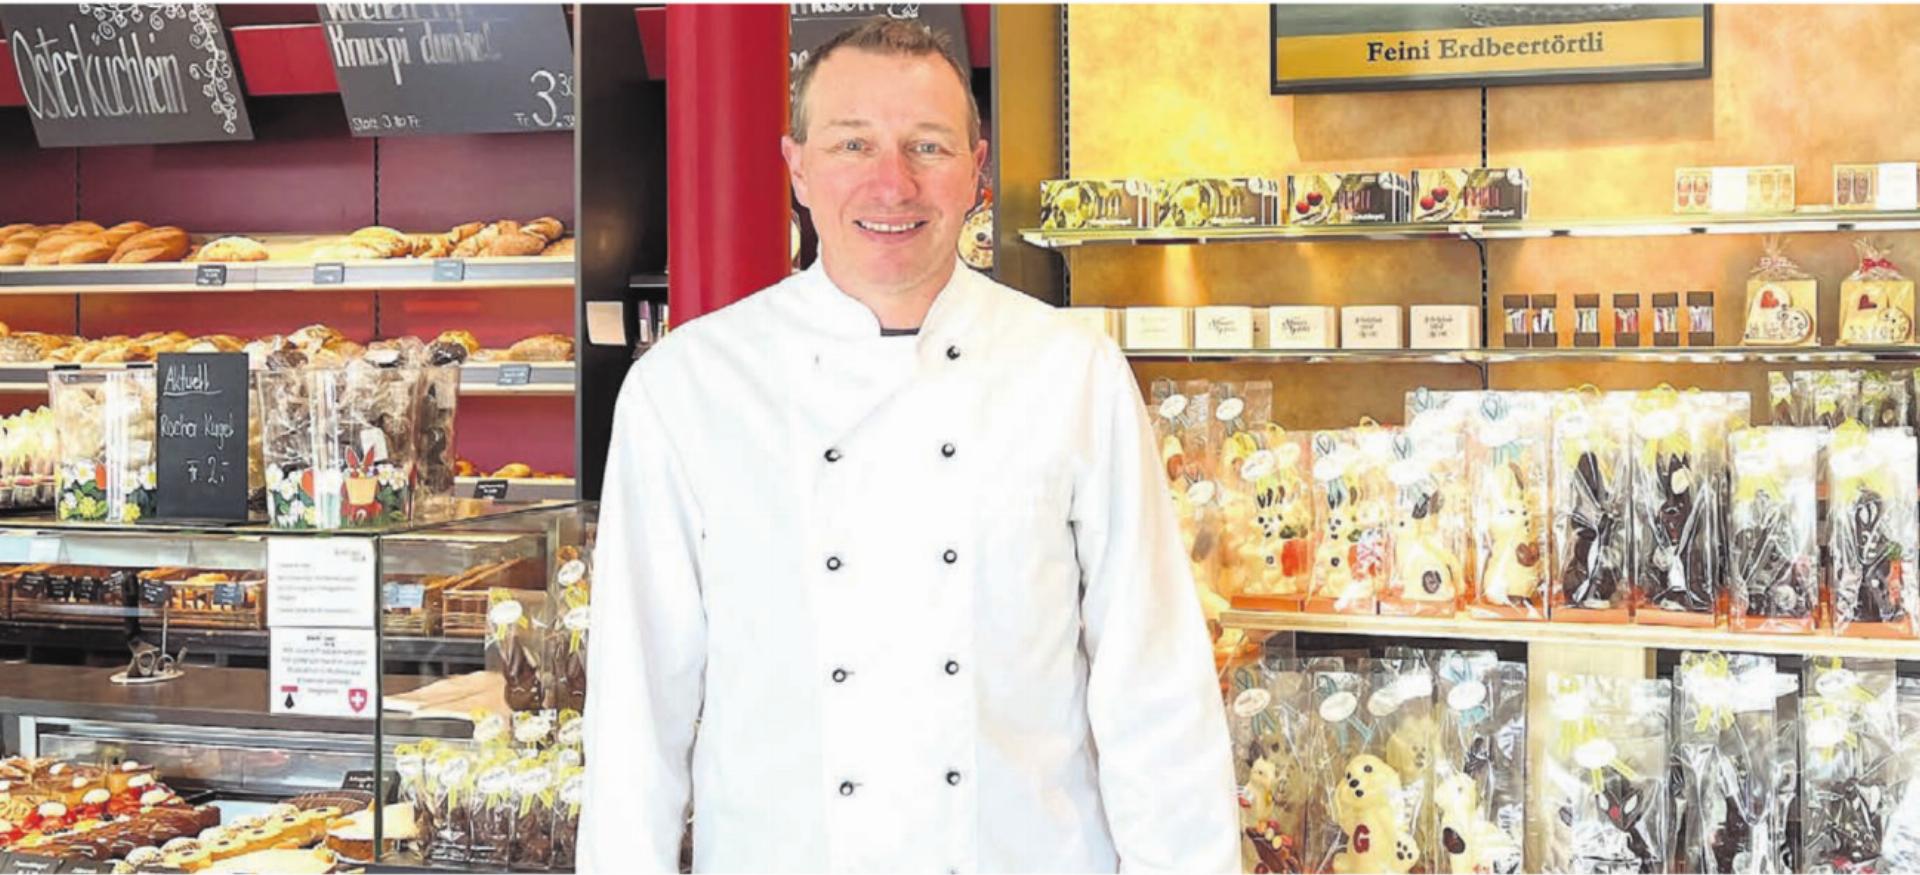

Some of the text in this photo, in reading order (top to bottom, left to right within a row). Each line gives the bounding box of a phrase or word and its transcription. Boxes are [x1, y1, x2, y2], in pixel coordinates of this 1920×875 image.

[328, 24, 411, 86] Knuspi
[1367, 33, 1604, 62] Feini Erdbeertörtli
[163, 363, 210, 393] Aktuell
